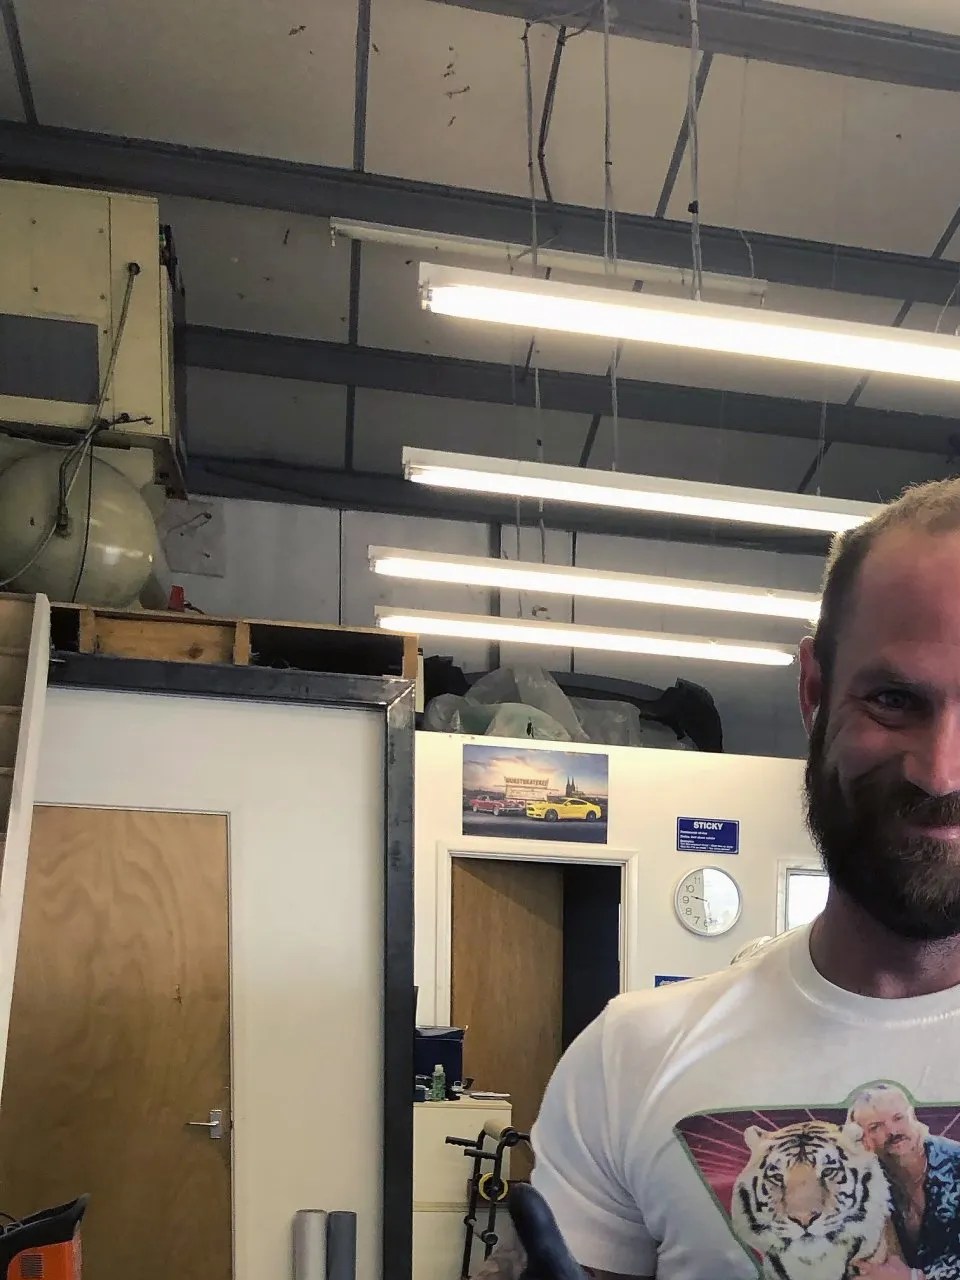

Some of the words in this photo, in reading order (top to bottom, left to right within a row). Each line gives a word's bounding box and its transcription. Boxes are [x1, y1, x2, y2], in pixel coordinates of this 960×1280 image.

[693, 821, 723, 830] STICKY
[686, 884, 695, 893] 10
[682, 895, 690, 904] 9
[685, 907, 692, 915] 8
[694, 916, 700, 924] 7
